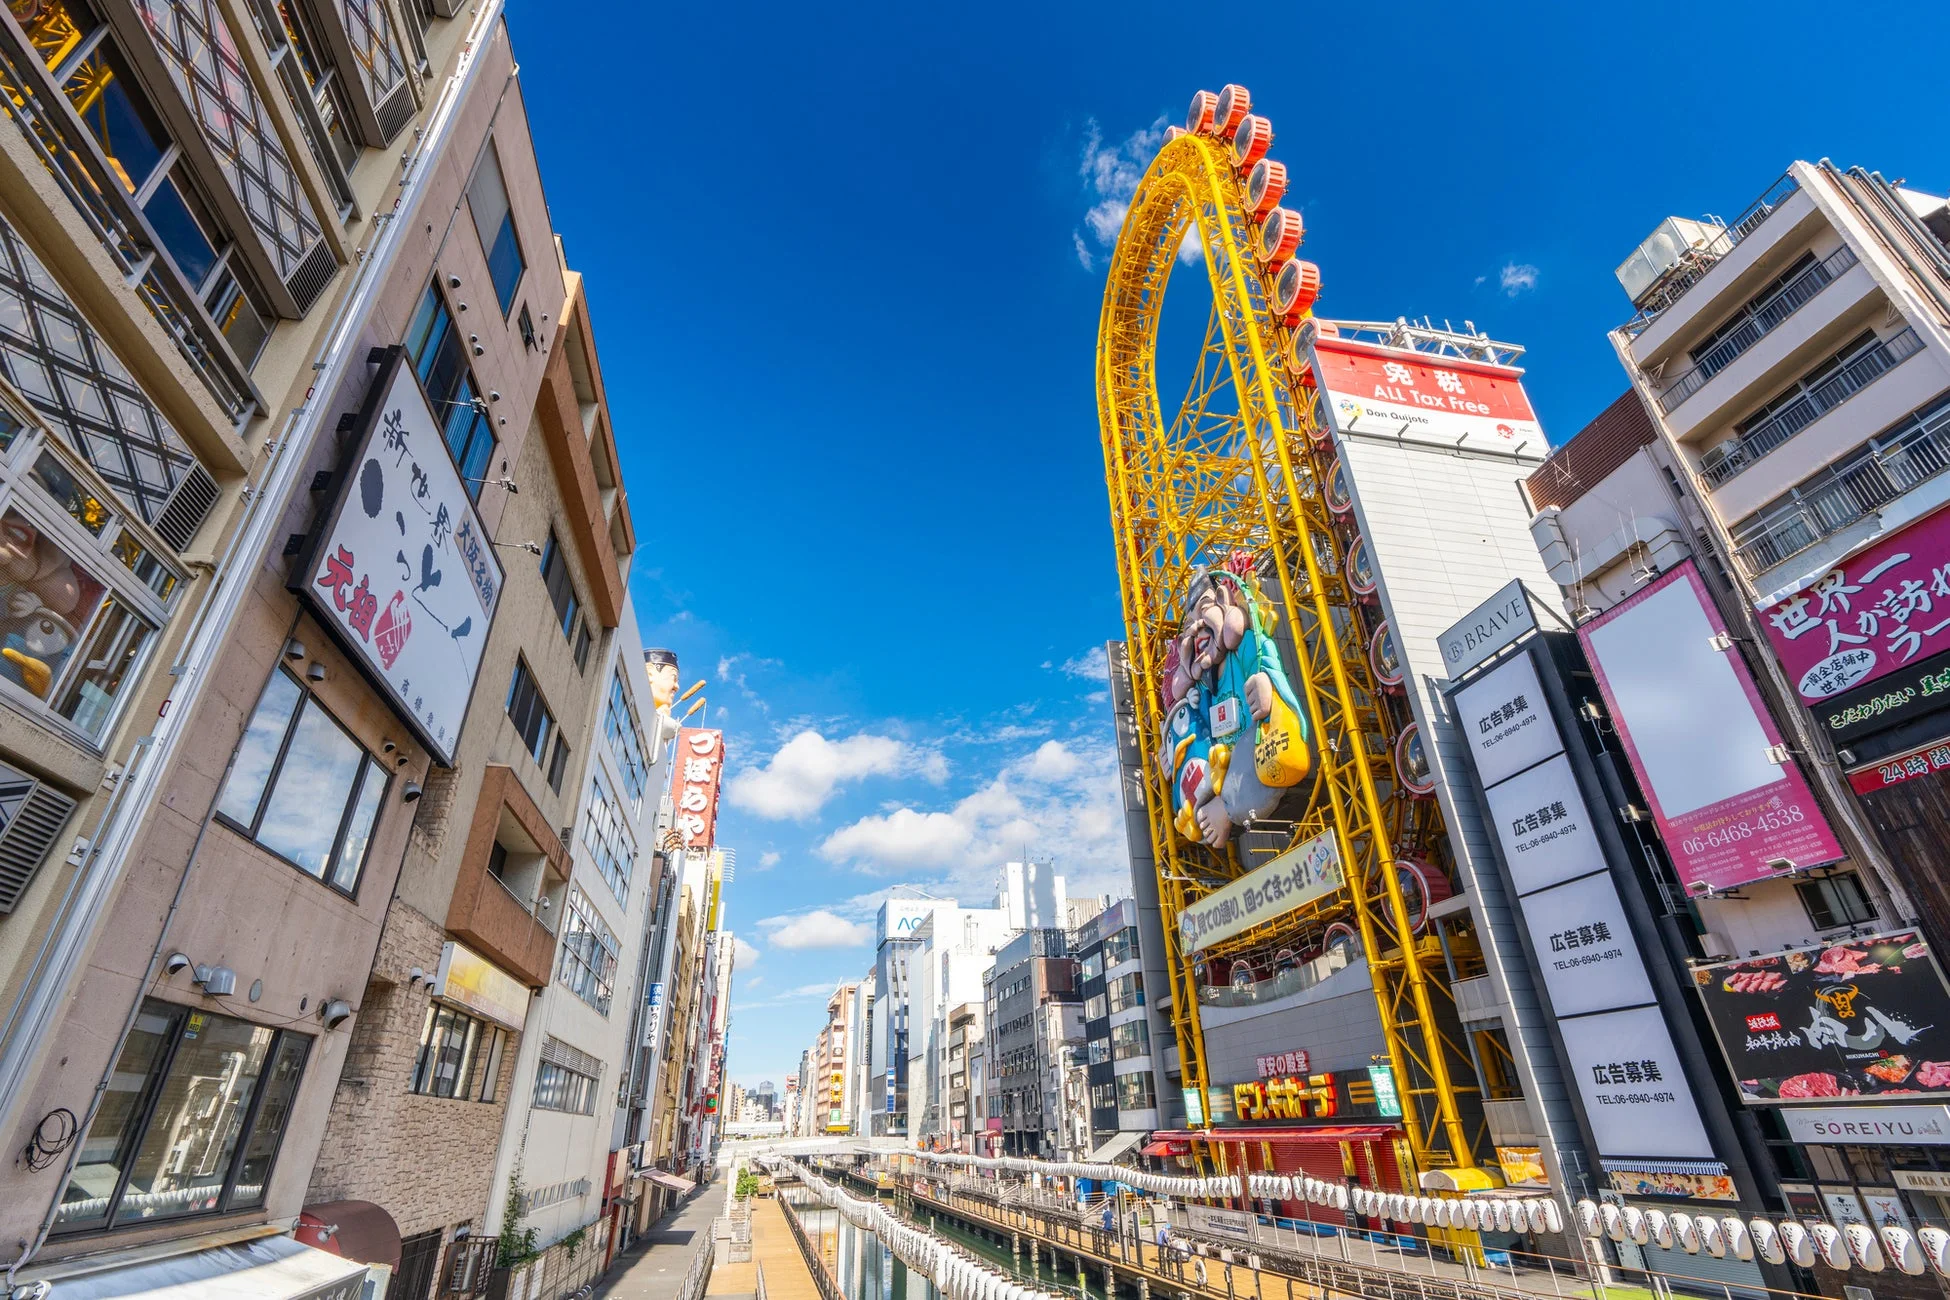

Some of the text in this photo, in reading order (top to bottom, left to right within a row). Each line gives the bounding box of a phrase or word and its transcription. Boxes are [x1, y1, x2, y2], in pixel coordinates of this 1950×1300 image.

[1382, 362, 1465, 395] 免税
[1366, 407, 1429, 425] Don Quijote
[1374, 384, 1490, 415] ALL Tax Free
[456, 519, 496, 608] 大阪名物
[317, 543, 378, 644] 元祖
[1769, 552, 1911, 640] 世界一
[1464, 598, 1524, 652] BRAVE
[1802, 650, 1870, 692] 一蘭全店舗中
[1820, 670, 1862, 695] 世界一
[1478, 694, 1529, 734] 広告募集
[1829, 686, 1916, 729] こだわりたい
[1481, 714, 1537, 750] TEL:06-6940-4974
[1878, 746, 1950, 784] 24時間
[678, 731, 720, 843] づぼらや
[1511, 800, 1568, 837] 広告募集
[1682, 805, 1804, 856] 06-6468-4538
[1515, 823, 1577, 854] TEL:06-6940-4974
[1549, 921, 1612, 953] 広告募集
[1553, 949, 1623, 971] TEL:06-6940-4974
[1745, 1030, 1801, 1052] 和牛焼肉
[1592, 1059, 1663, 1085] 広告募集
[1596, 1092, 1675, 1105] TEL:06-6940-4974
[1814, 1122, 1914, 1135] SOREIYU
